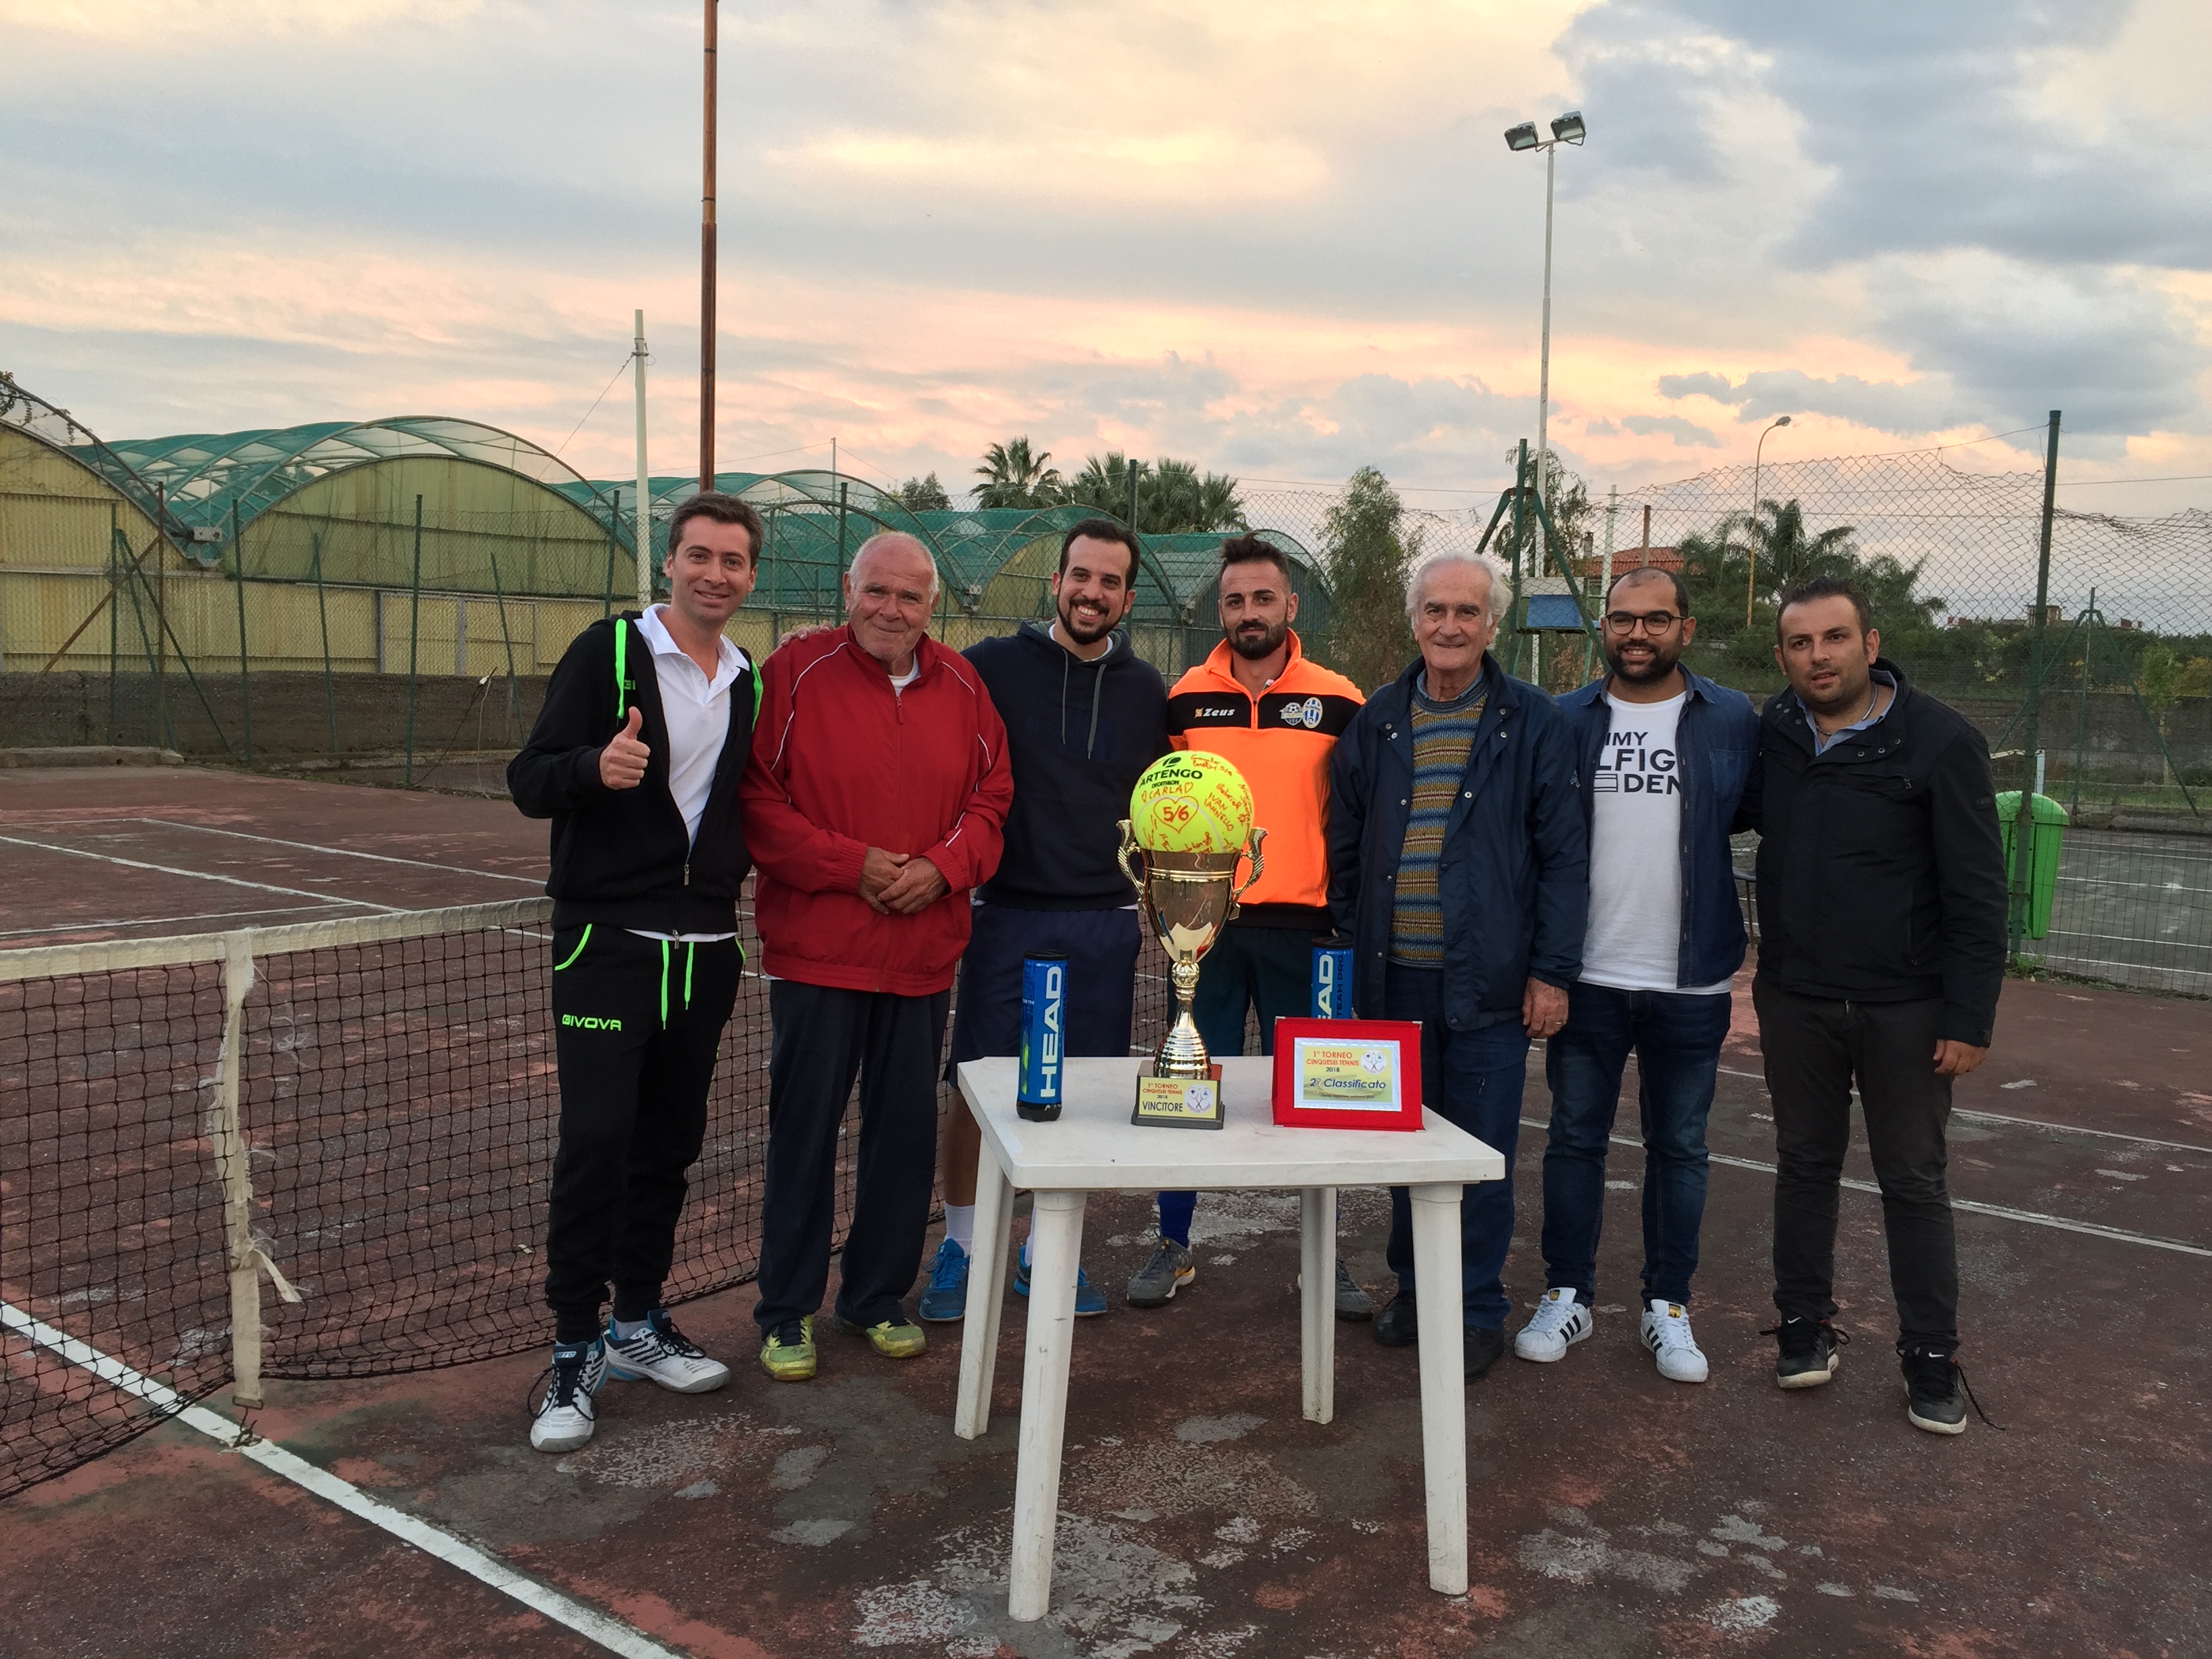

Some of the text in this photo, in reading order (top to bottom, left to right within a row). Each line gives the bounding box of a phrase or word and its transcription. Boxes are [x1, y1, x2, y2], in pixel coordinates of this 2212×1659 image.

[1203, 708, 1235, 717] Zeus
[1139, 769, 1203, 789] ARTENGO
[1151, 780, 1180, 789] DECATHLON
[1149, 784, 1183, 799] CARLA
[1208, 792, 1228, 811] IVAN
[1162, 804, 1189, 823] 5/6
[562, 1014, 622, 1031] GIVOVA
[1040, 966, 1062, 1098] HEAD
[1324, 1078, 1386, 1089] Classificato
[1142, 1101, 1183, 1112] VINCITORE
